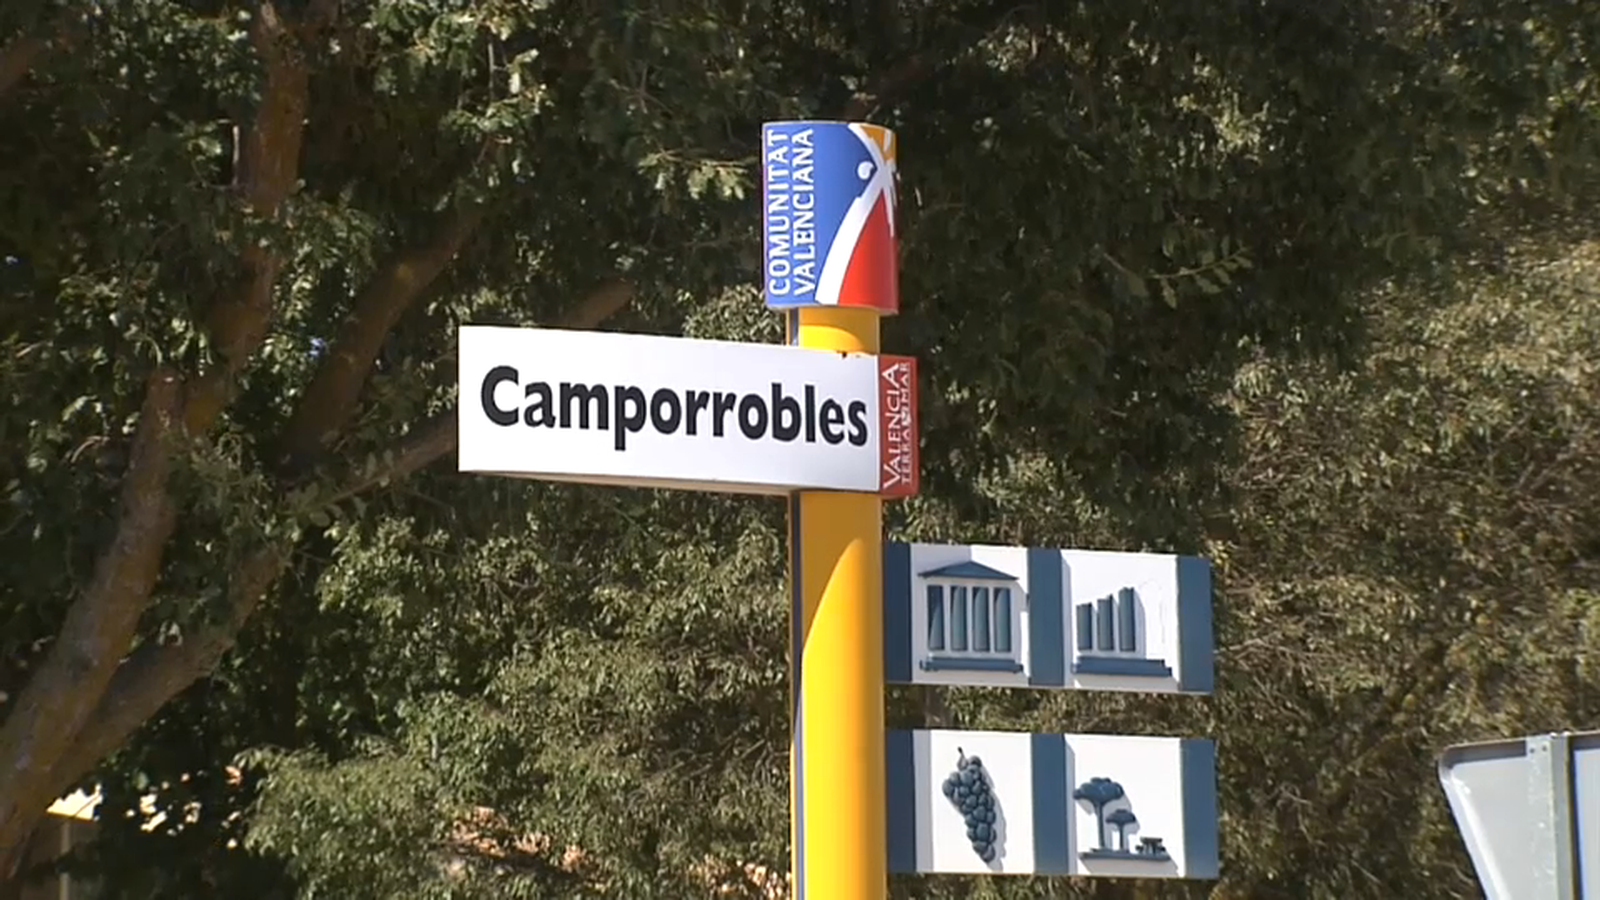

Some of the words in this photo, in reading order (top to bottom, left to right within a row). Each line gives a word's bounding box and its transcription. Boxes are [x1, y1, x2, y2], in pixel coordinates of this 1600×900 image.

[768, 129, 791, 296] COMUNITAT
[792, 129, 815, 296] VALENCIANA
[481, 365, 868, 450] Camporrobles
[882, 363, 901, 489] VALENCIA
